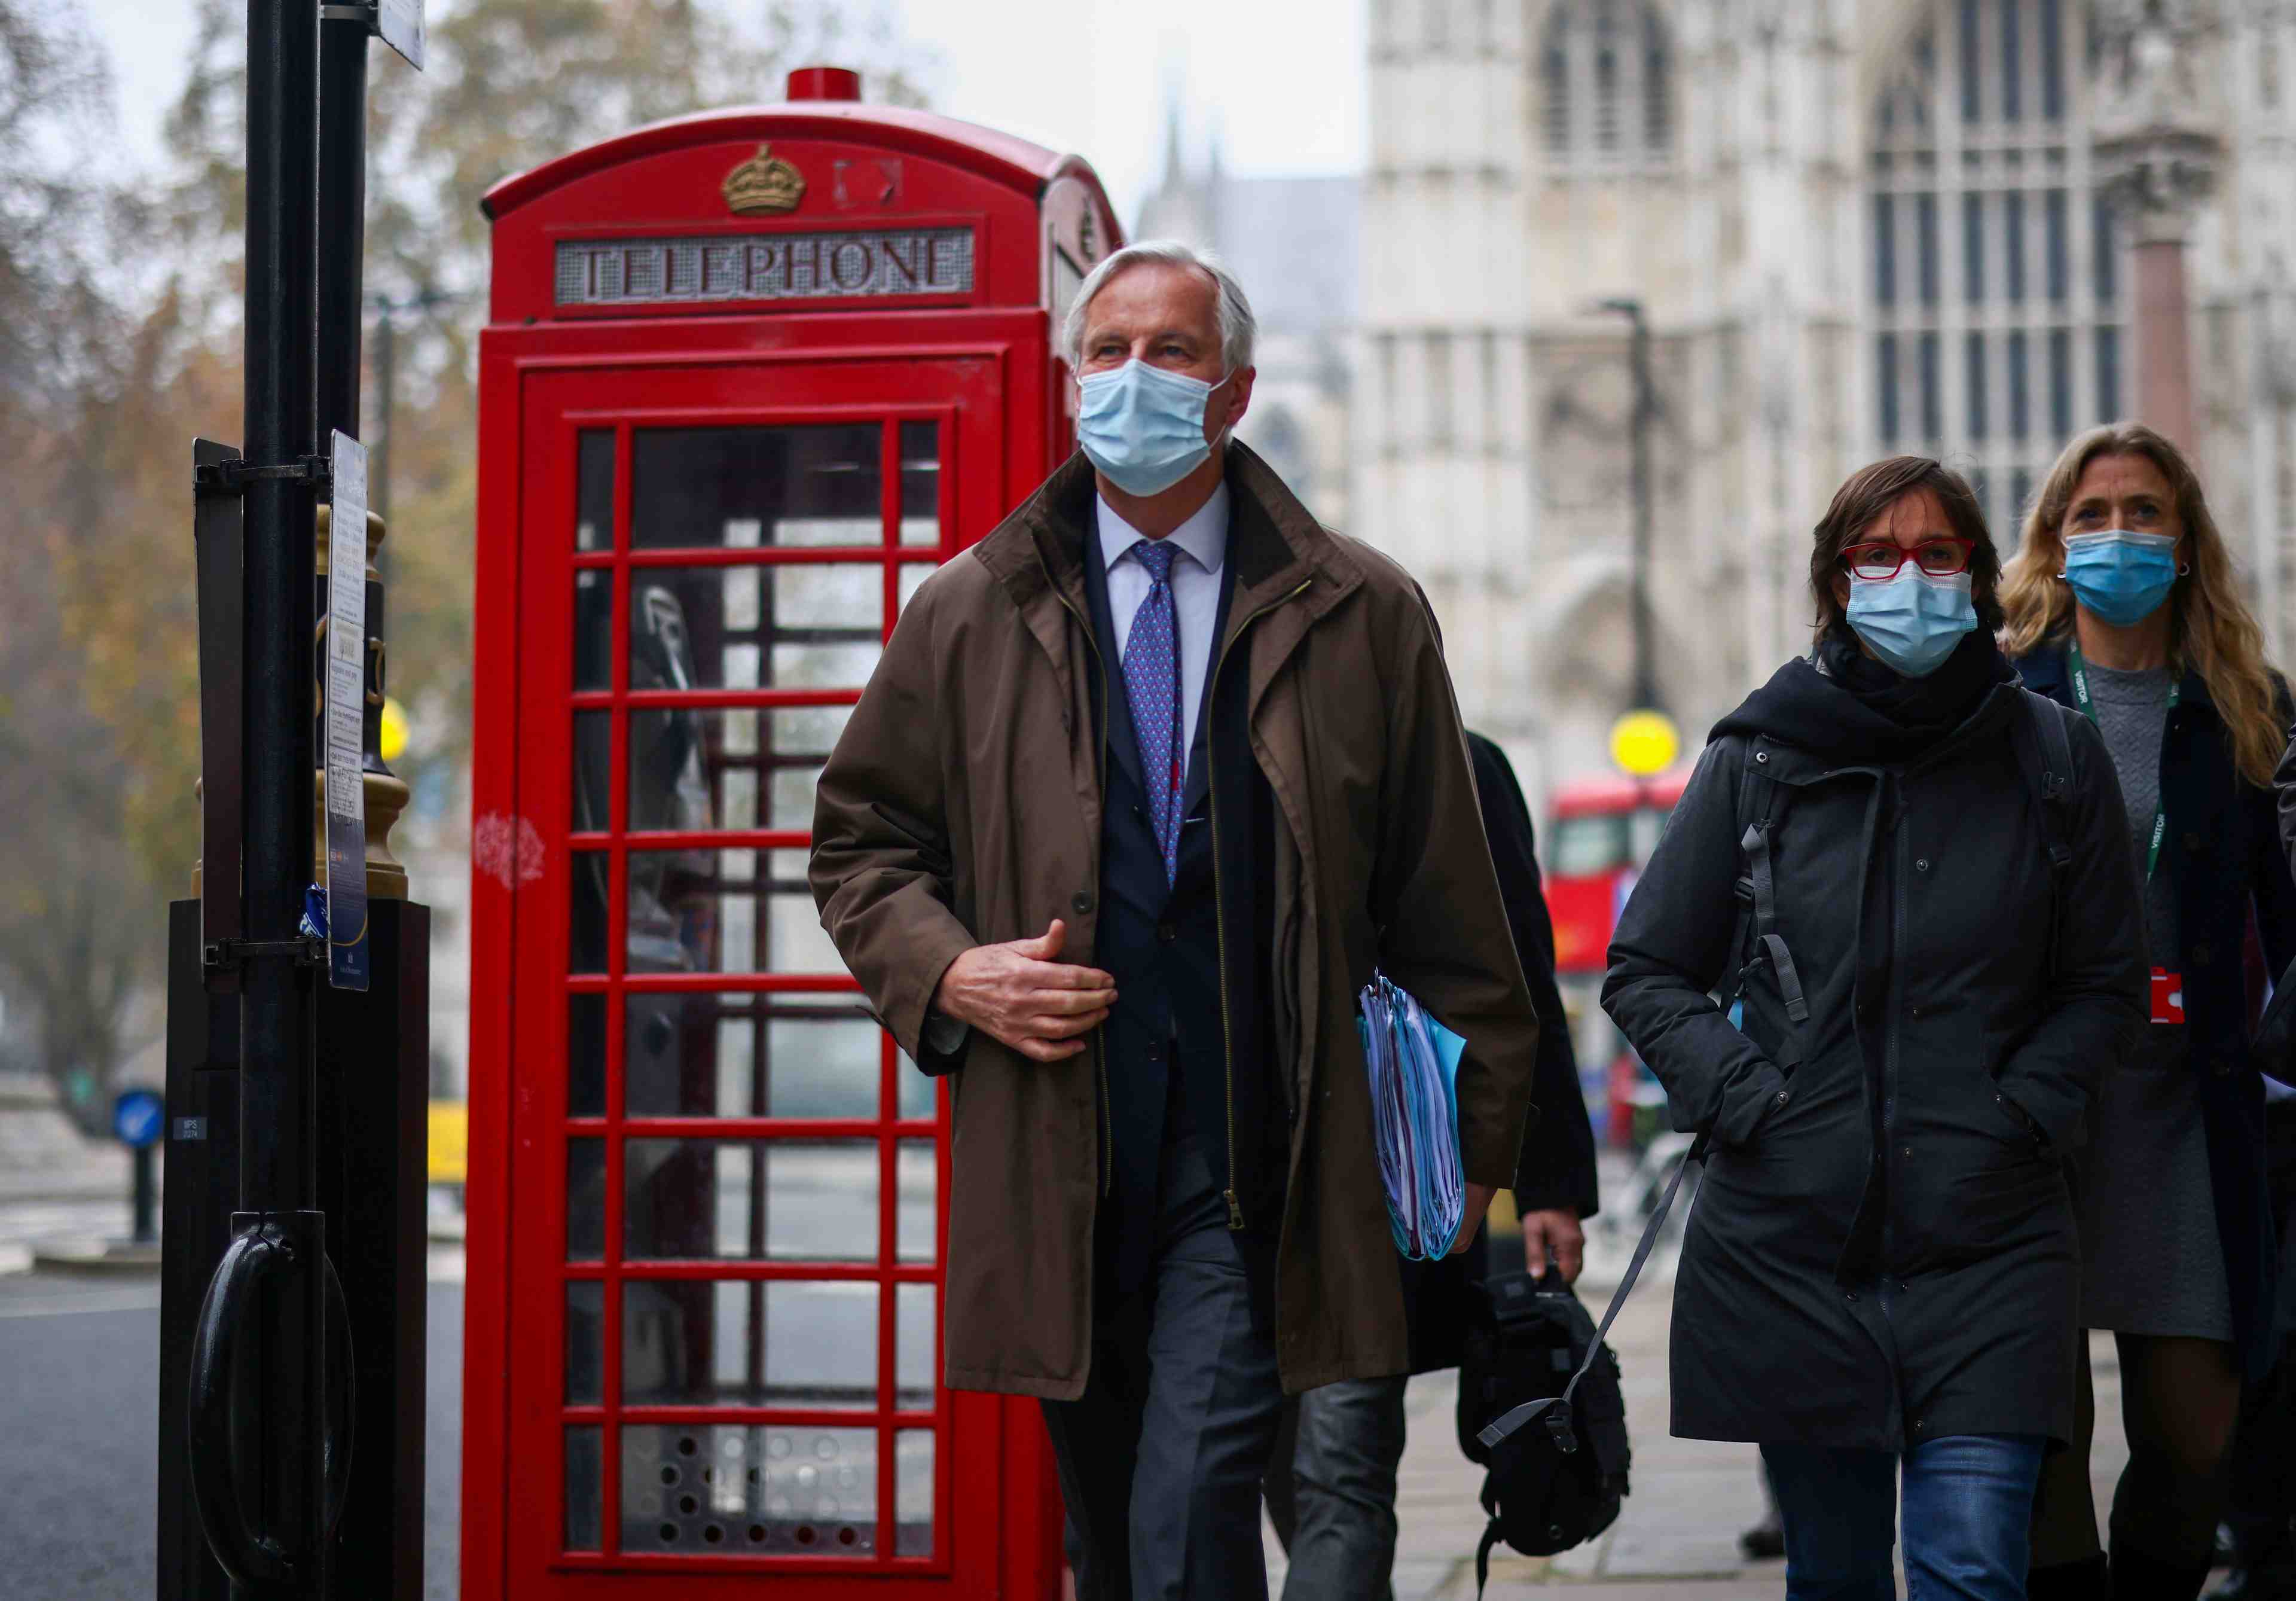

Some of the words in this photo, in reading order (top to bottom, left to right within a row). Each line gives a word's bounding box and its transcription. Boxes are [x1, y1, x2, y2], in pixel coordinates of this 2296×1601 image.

[576, 237, 957, 299] TELEPHONE
[2074, 670, 2088, 704] VISITOR
[2151, 813, 2164, 849] VISITOR
